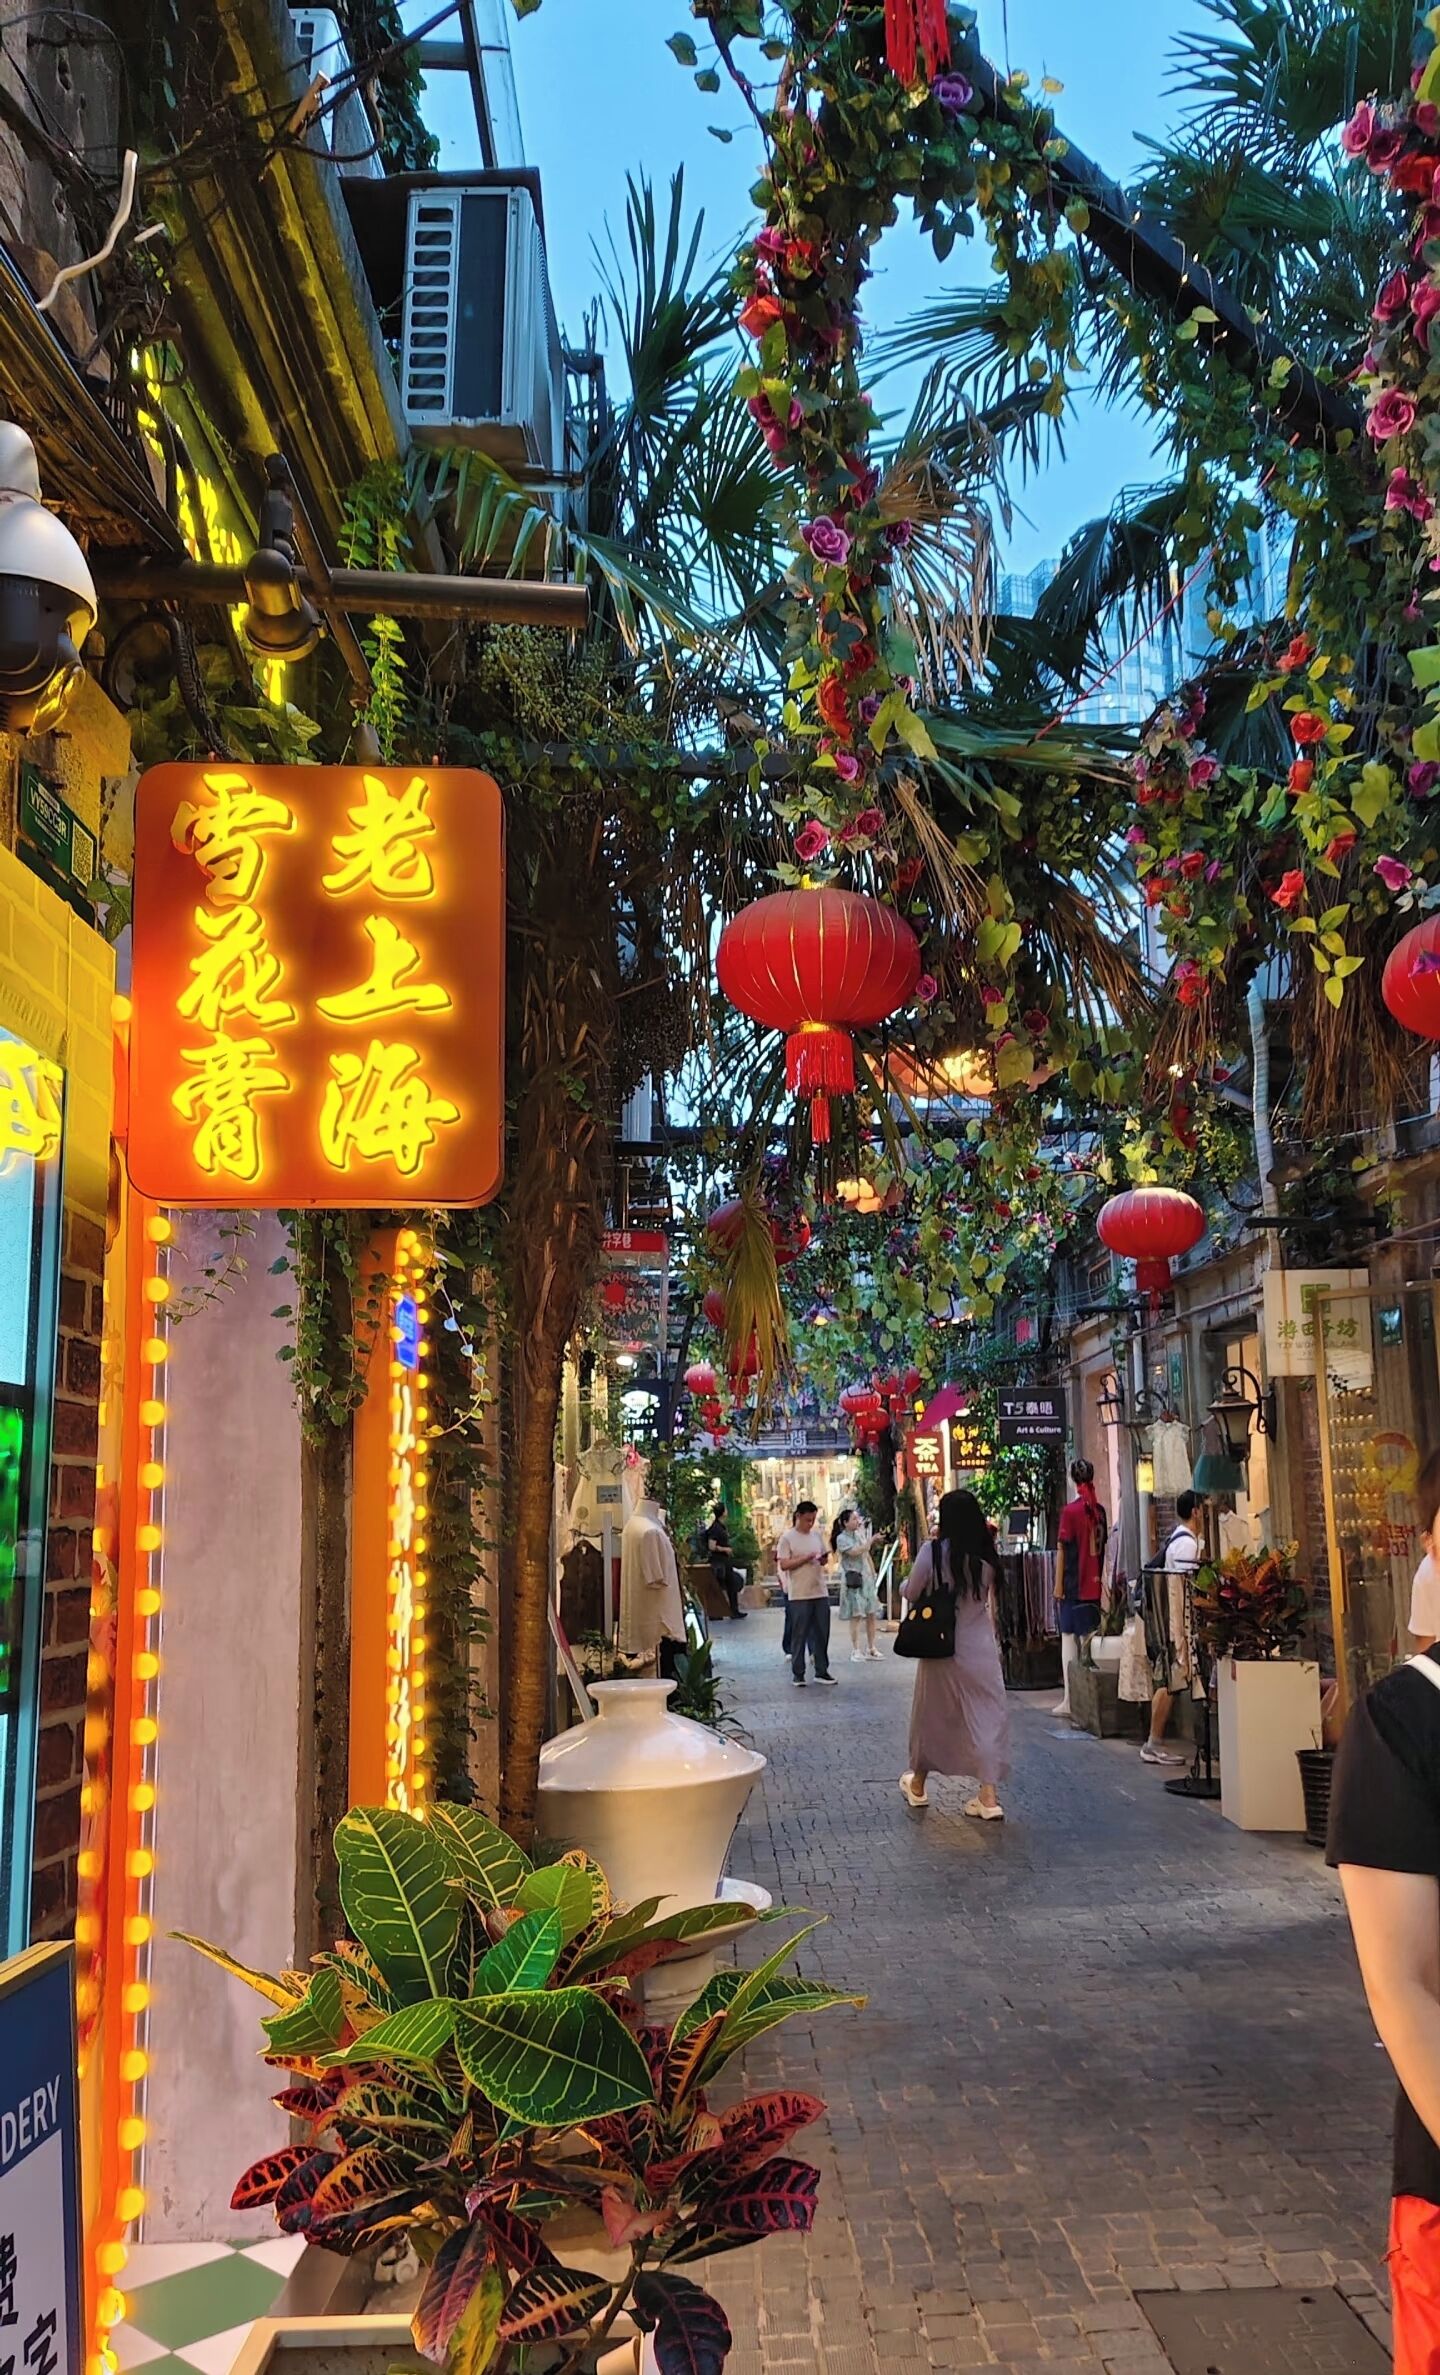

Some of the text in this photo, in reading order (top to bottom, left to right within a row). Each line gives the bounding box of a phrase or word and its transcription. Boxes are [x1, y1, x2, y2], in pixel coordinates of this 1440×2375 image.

[170, 772, 298, 1180] 雪花膏
[316, 774, 461, 1175] 老上海
[913, 1438, 940, 1462] 茶
[1016, 1426, 1062, 1435] Art & Culture
[916, 1462, 940, 1474] TEA
[1, 2075, 61, 2166] DERY
